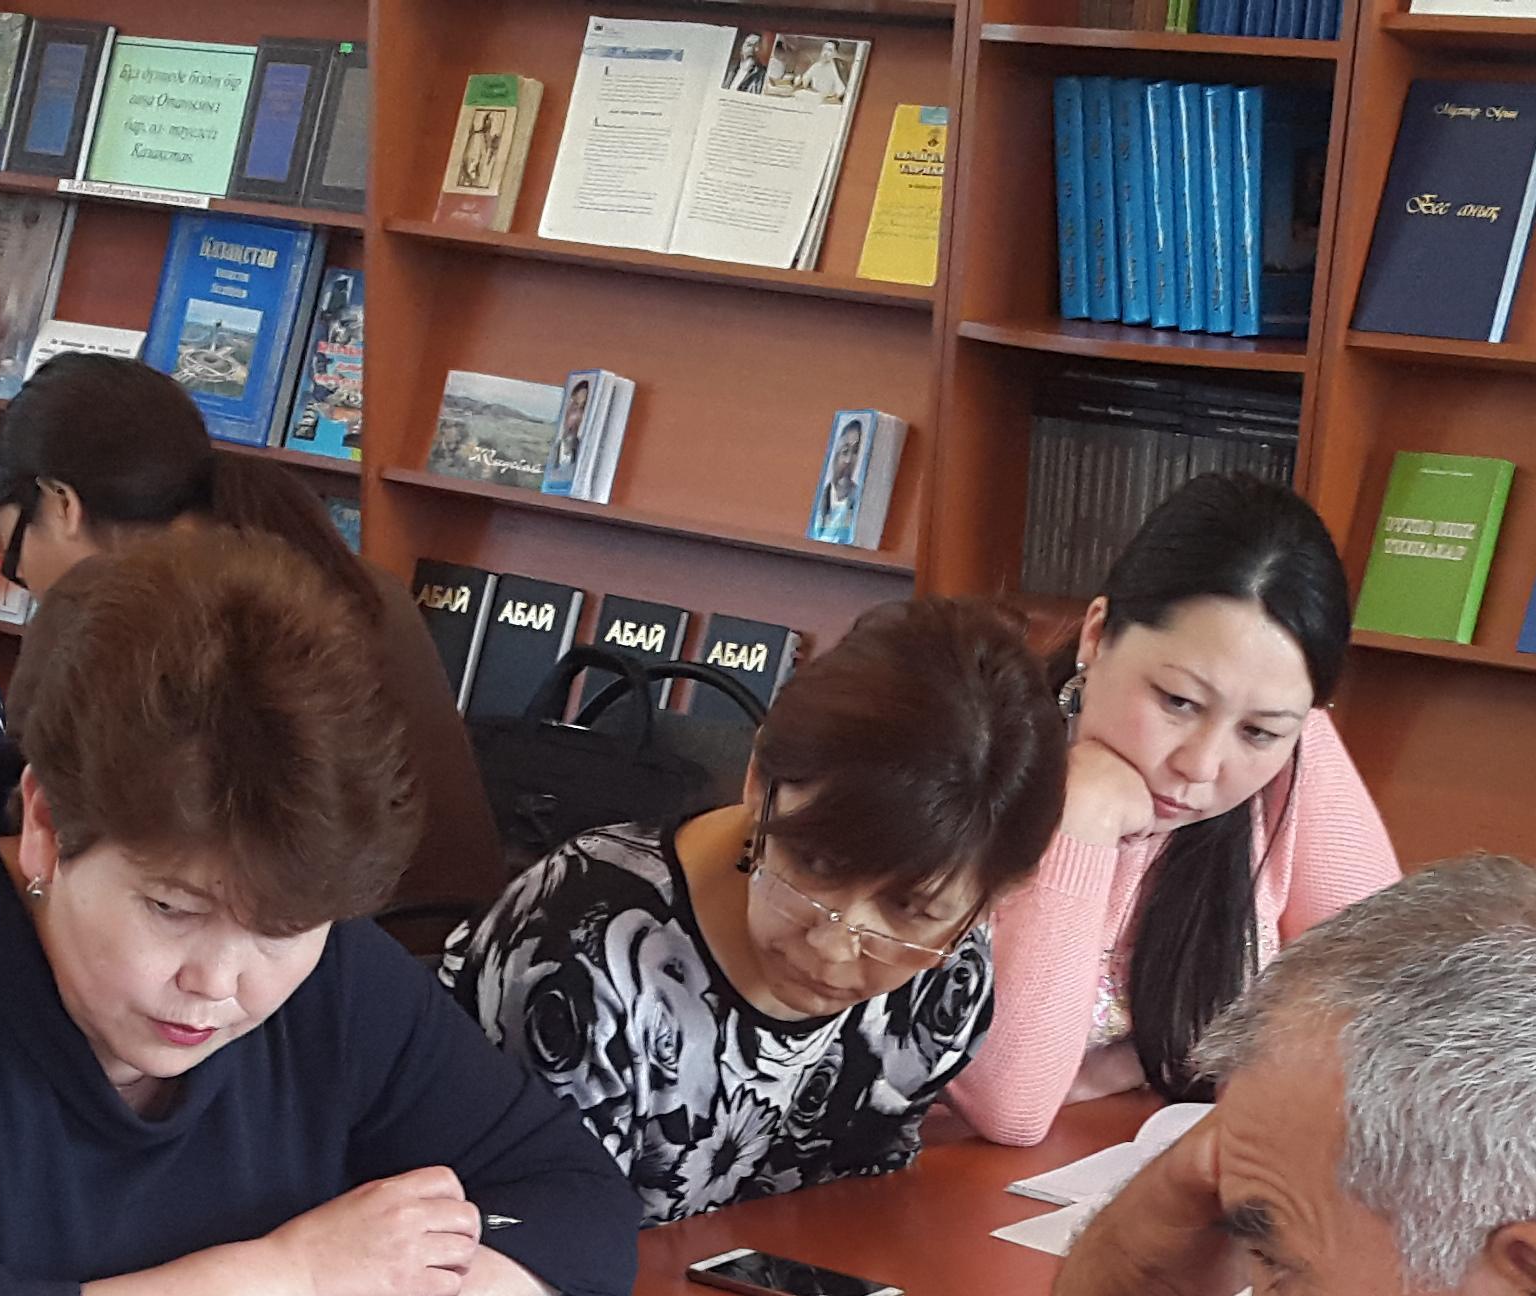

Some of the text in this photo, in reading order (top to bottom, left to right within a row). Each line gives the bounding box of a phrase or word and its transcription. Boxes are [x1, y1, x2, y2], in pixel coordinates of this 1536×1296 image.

[417, 583, 472, 615] АБАЙ
[497, 599, 558, 632] АБАЙ
[604, 618, 667, 653] АБАЙ
[706, 640, 770, 673] АБАЙ
